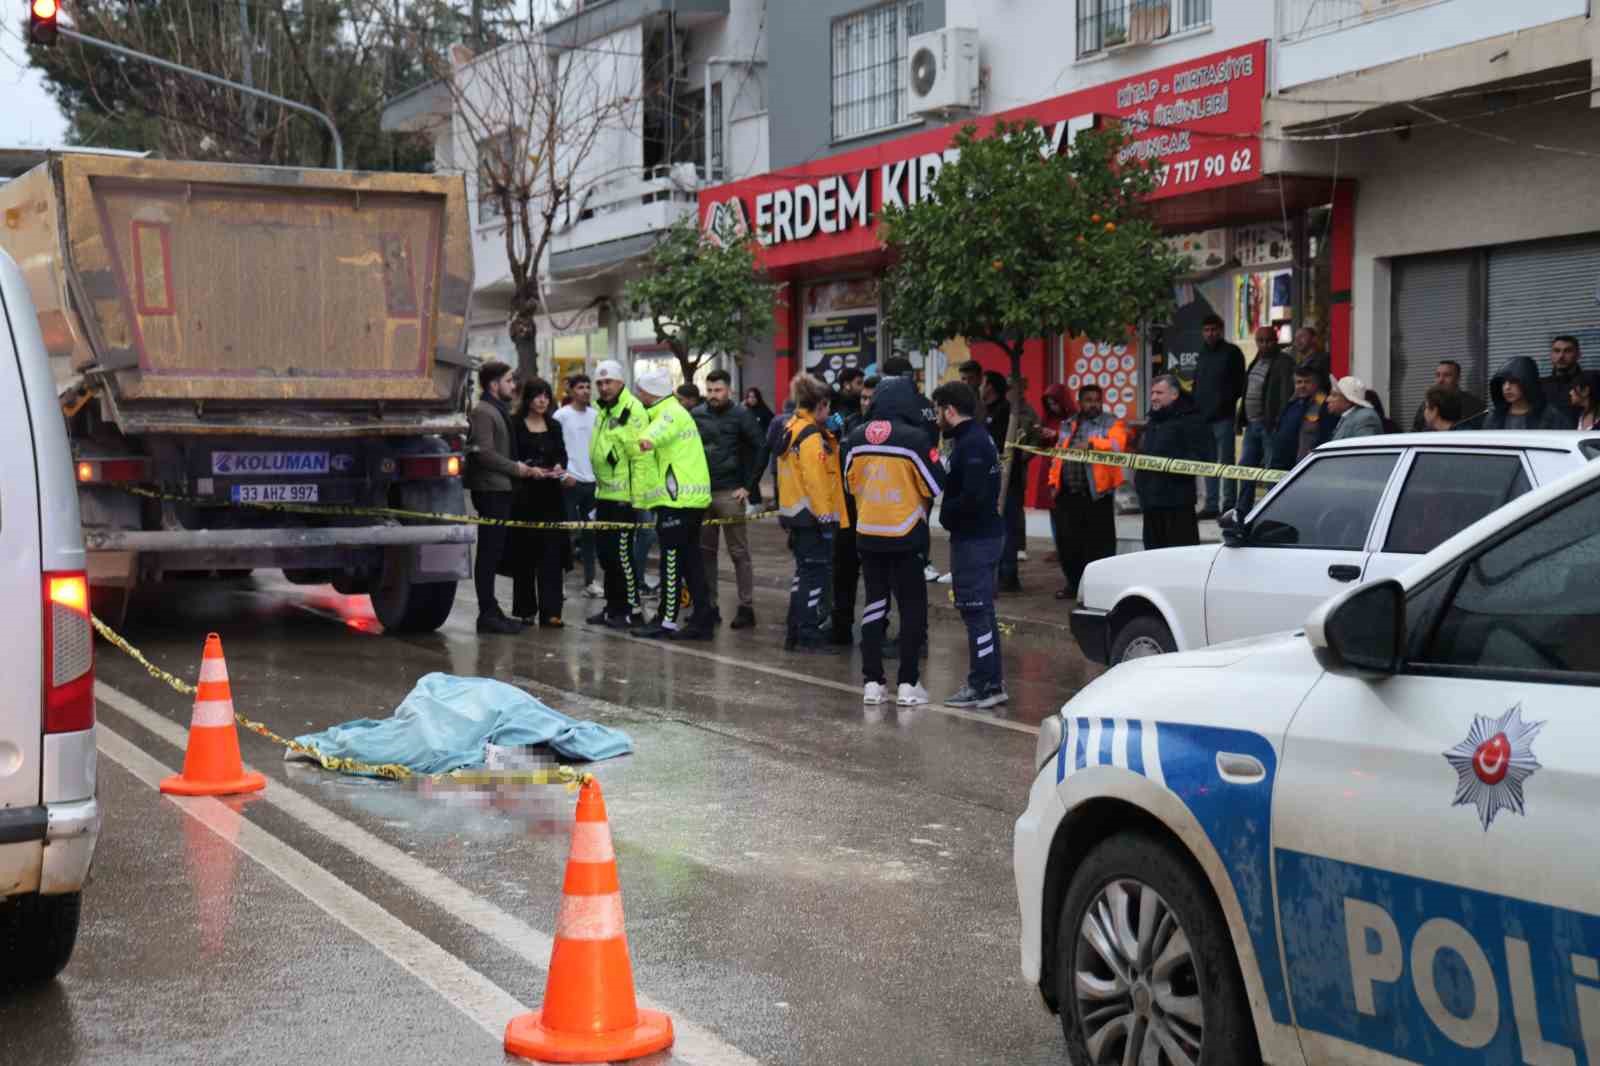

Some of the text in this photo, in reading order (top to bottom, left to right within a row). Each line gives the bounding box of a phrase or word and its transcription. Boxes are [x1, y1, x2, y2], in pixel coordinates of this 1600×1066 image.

[1174, 159, 1200, 184] 717
[1204, 154, 1225, 178] 90
[1230, 148, 1251, 174] 62
[756, 169, 867, 247] ERDEM
[235, 455, 326, 470] KOLUMAN
[242, 486, 313, 500] 33 AHZ 997
